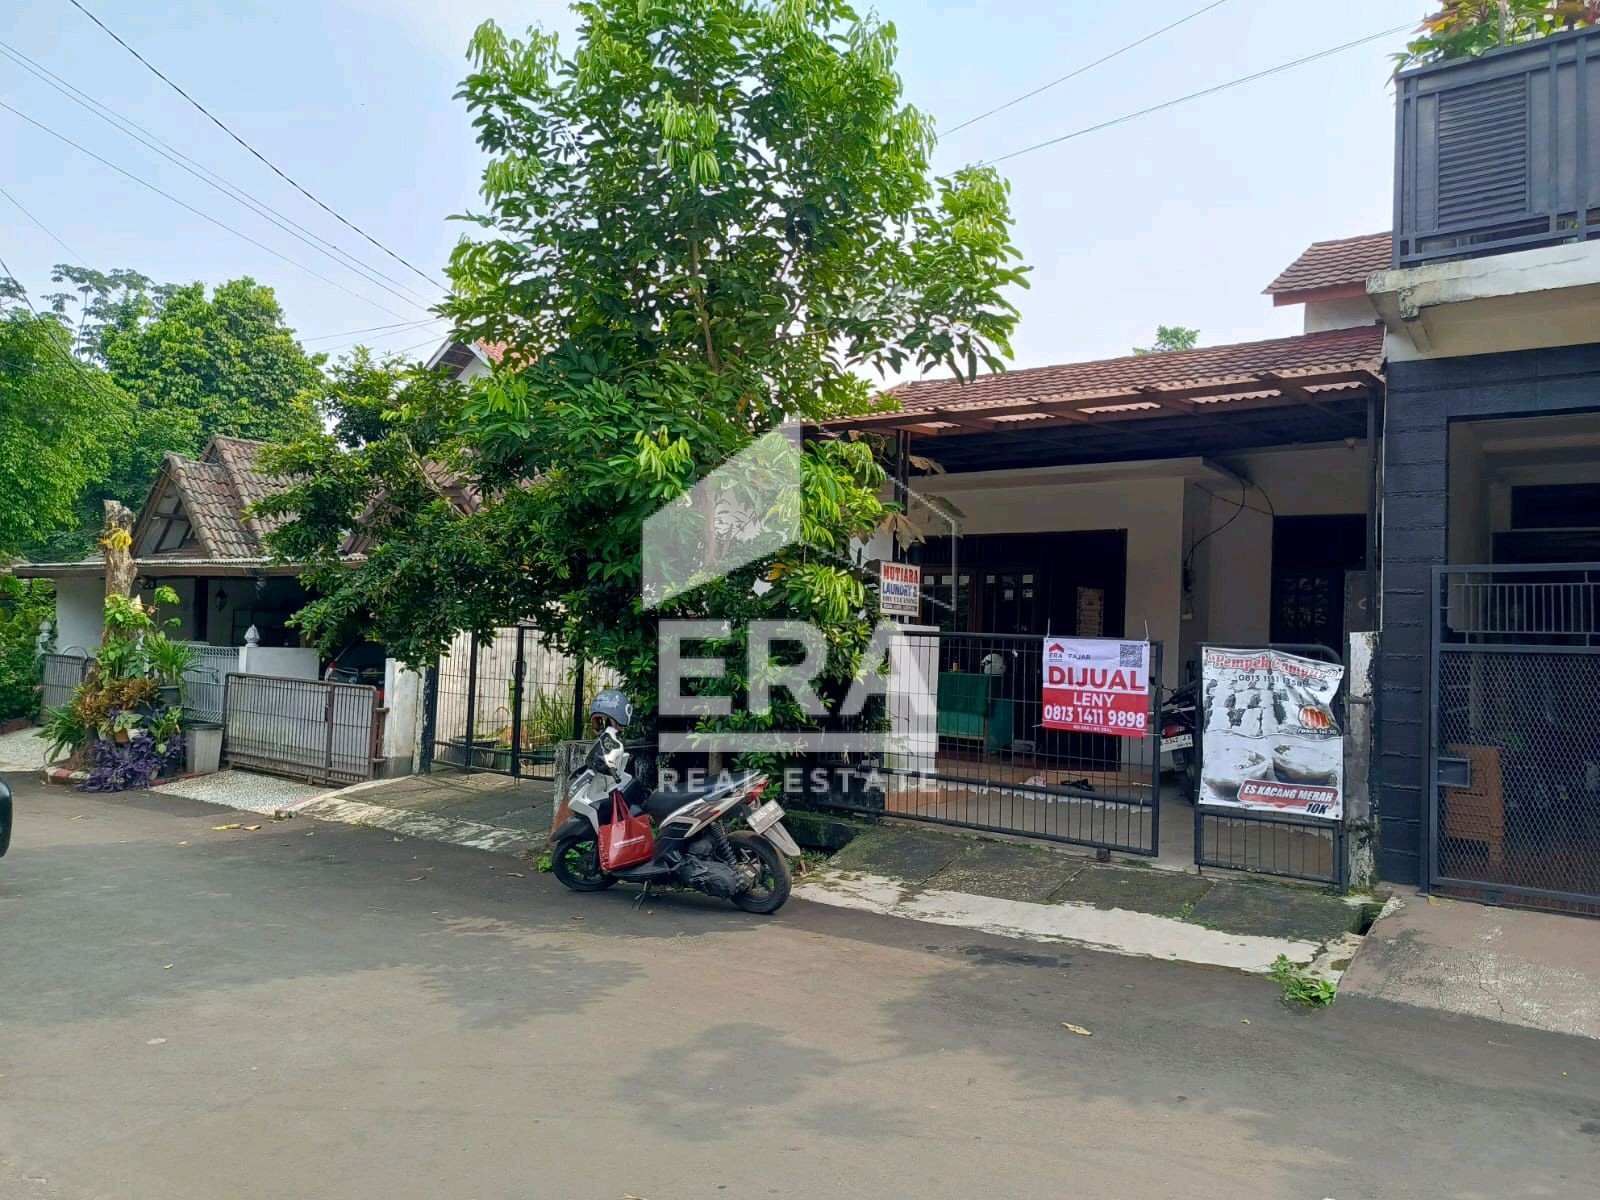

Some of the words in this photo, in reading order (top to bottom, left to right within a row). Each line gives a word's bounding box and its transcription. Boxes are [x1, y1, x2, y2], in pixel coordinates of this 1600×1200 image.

[883, 563, 919, 584] MUTIARA
[1068, 653, 1091, 661] FAJAR
[1048, 665, 1146, 692] DIJUAL
[1238, 674, 1261, 682] 0813
[1073, 691, 1115, 708] LENY
[1044, 704, 1073, 722] 0813
[1077, 707, 1103, 725] 1411
[1107, 709, 1146, 729] 9898
[1243, 784, 1257, 795] ES
[1257, 785, 1297, 799] KACANG
[1297, 788, 1334, 803] MERAH
[1305, 801, 1330, 815] 10K
